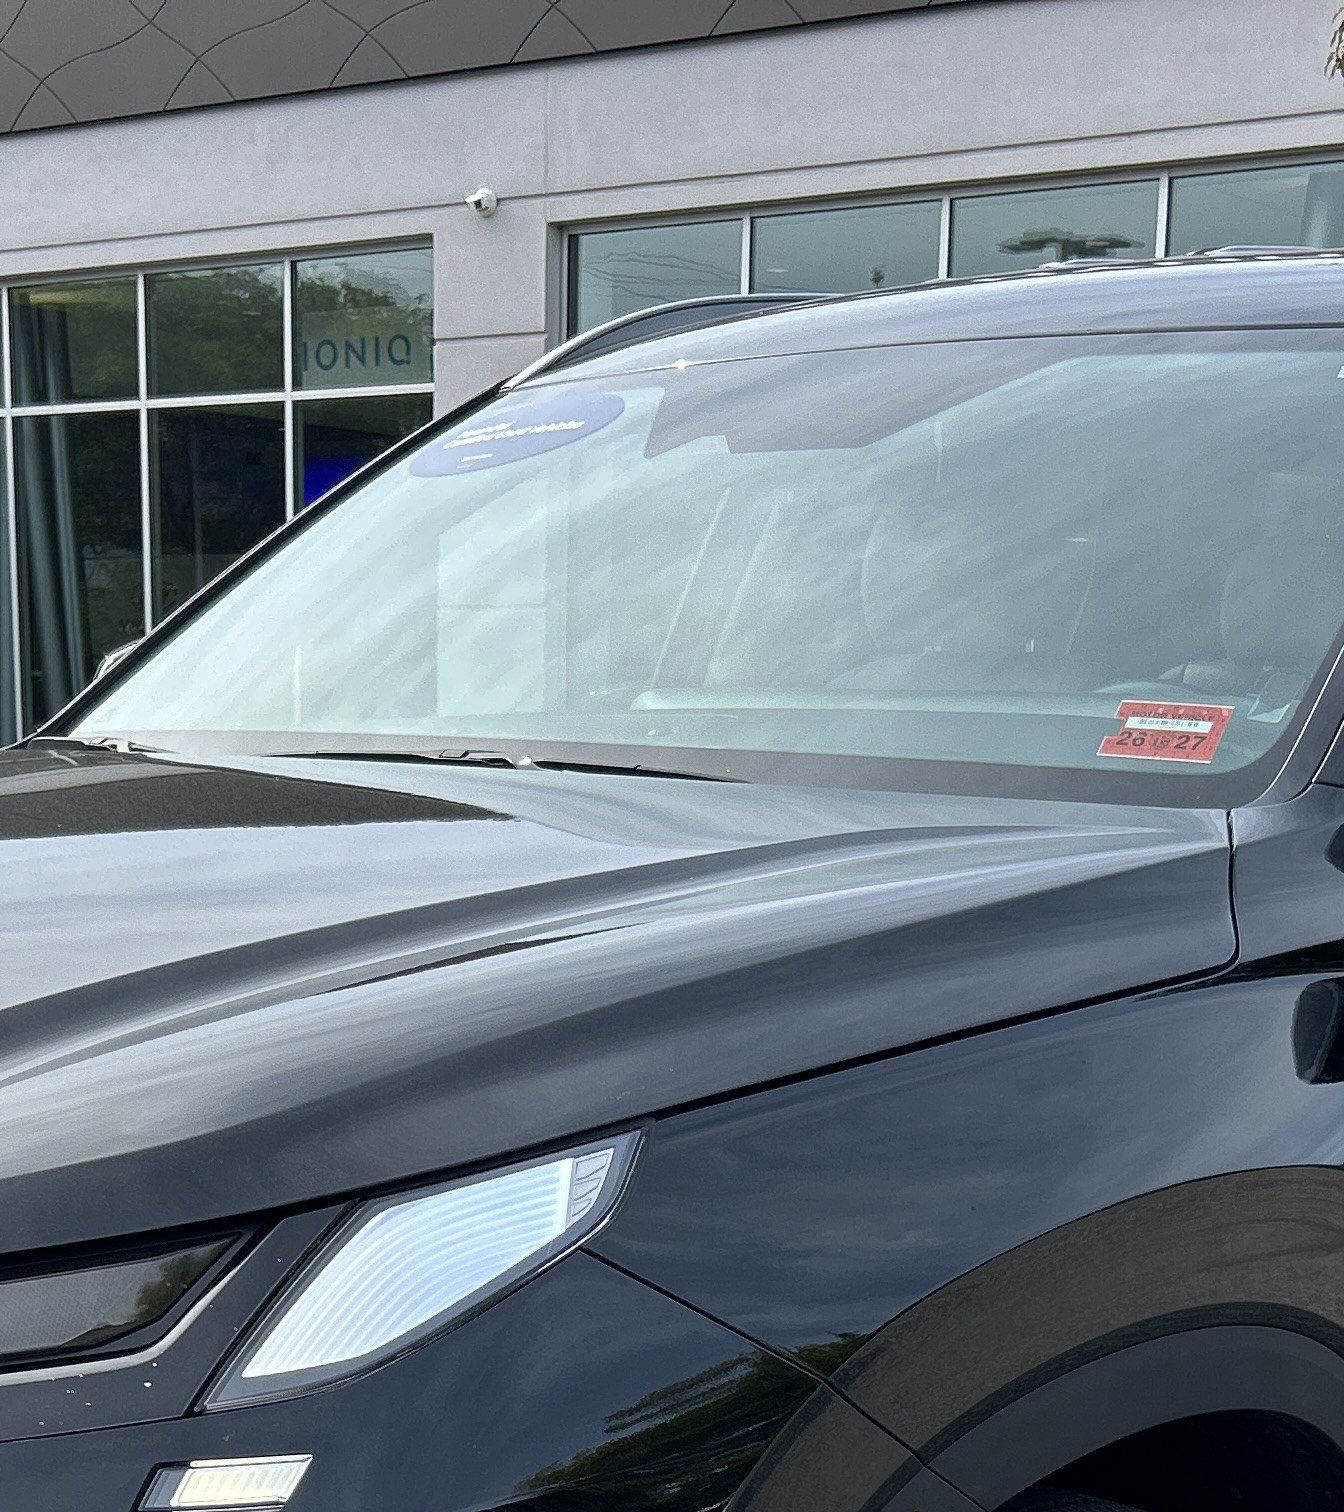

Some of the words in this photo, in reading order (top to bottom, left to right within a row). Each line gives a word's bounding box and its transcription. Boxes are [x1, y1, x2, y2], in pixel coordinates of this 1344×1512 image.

[300, 333, 412, 372] IONIQ
[1115, 730, 1148, 747] 26
[1173, 734, 1208, 751] 27
